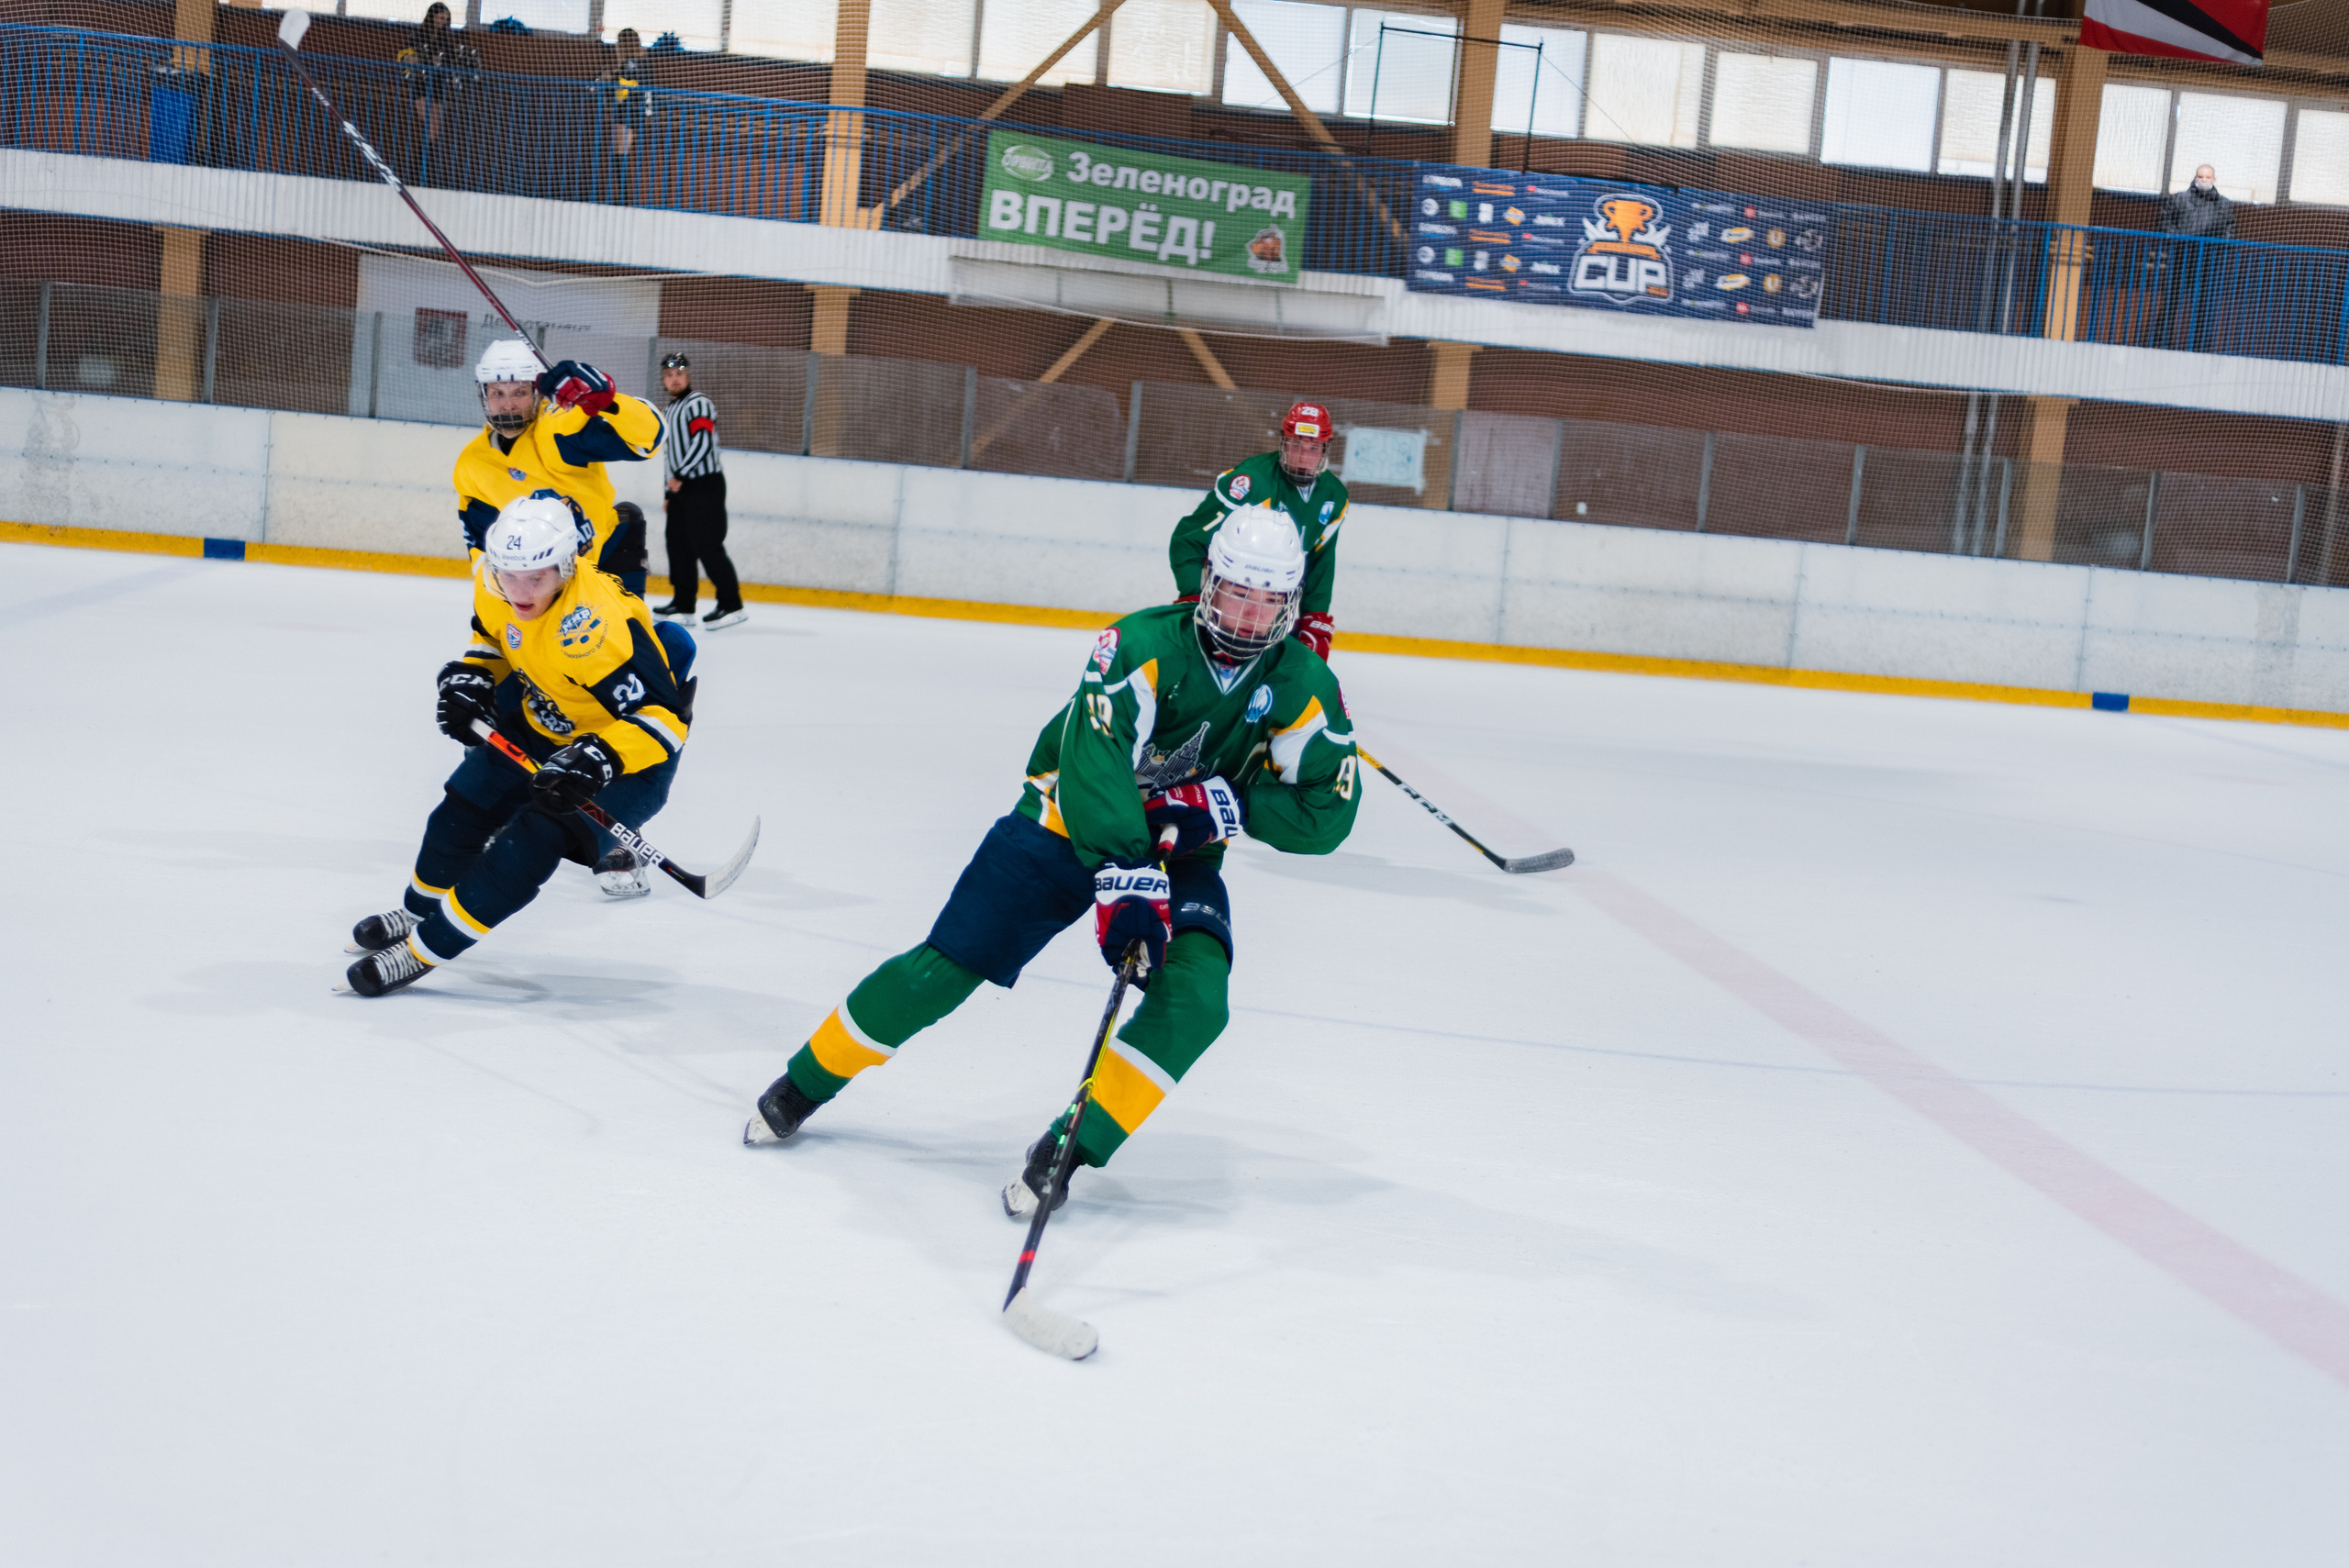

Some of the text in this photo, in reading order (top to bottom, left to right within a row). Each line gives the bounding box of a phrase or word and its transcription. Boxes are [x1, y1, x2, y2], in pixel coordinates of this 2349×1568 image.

[1066, 151, 1296, 219] Зеленоград
[988, 189, 1216, 265] ВПЕРЁД!
[1574, 255, 1666, 294] CUP
[1301, 406, 1319, 417] 28
[507, 535, 522, 550] 24
[502, 553, 528, 562] Reebok
[439, 673, 492, 695] CCM
[610, 822, 666, 867] BAUER
[1095, 875, 1168, 895] BAUER
